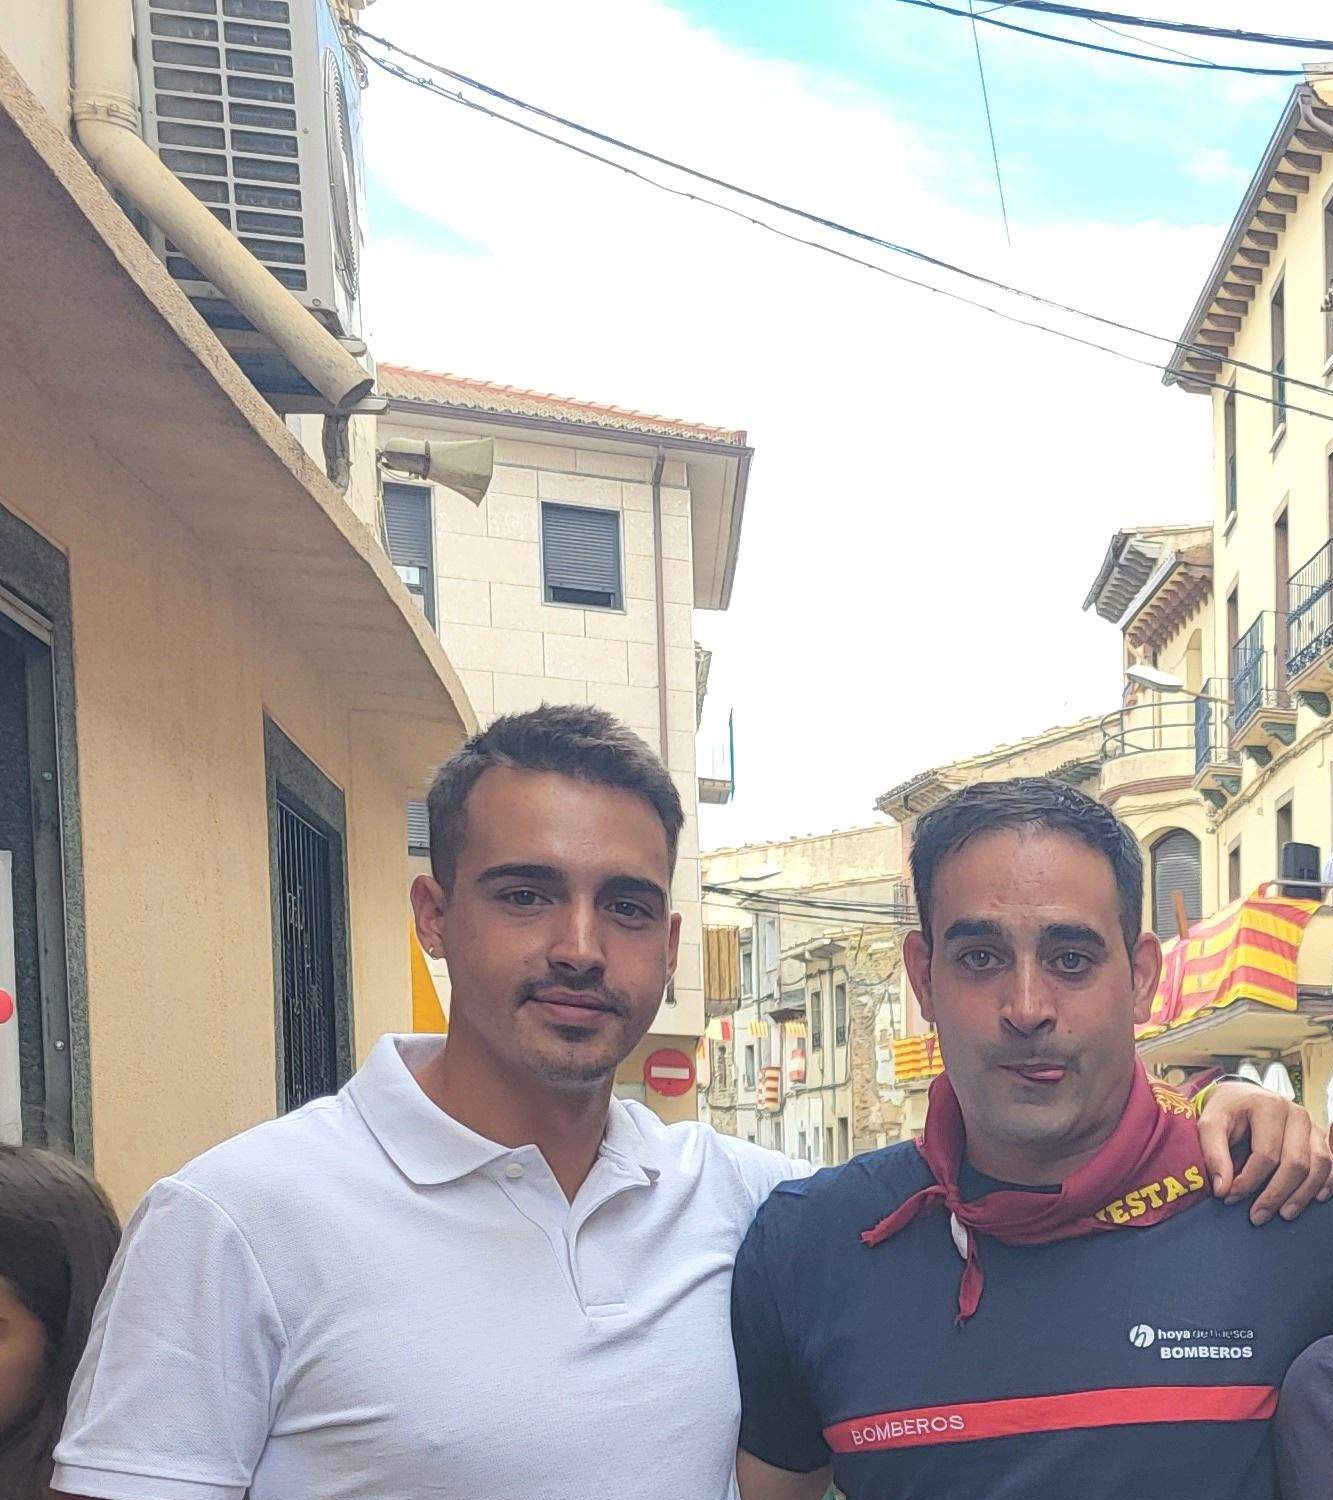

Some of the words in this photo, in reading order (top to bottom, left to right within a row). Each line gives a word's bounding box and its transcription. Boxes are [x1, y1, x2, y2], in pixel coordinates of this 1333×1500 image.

[1157, 1329, 1191, 1341] hoya
[1160, 1346, 1253, 1359] BOMBEROS
[851, 1415, 965, 1446] BOMBEROS
